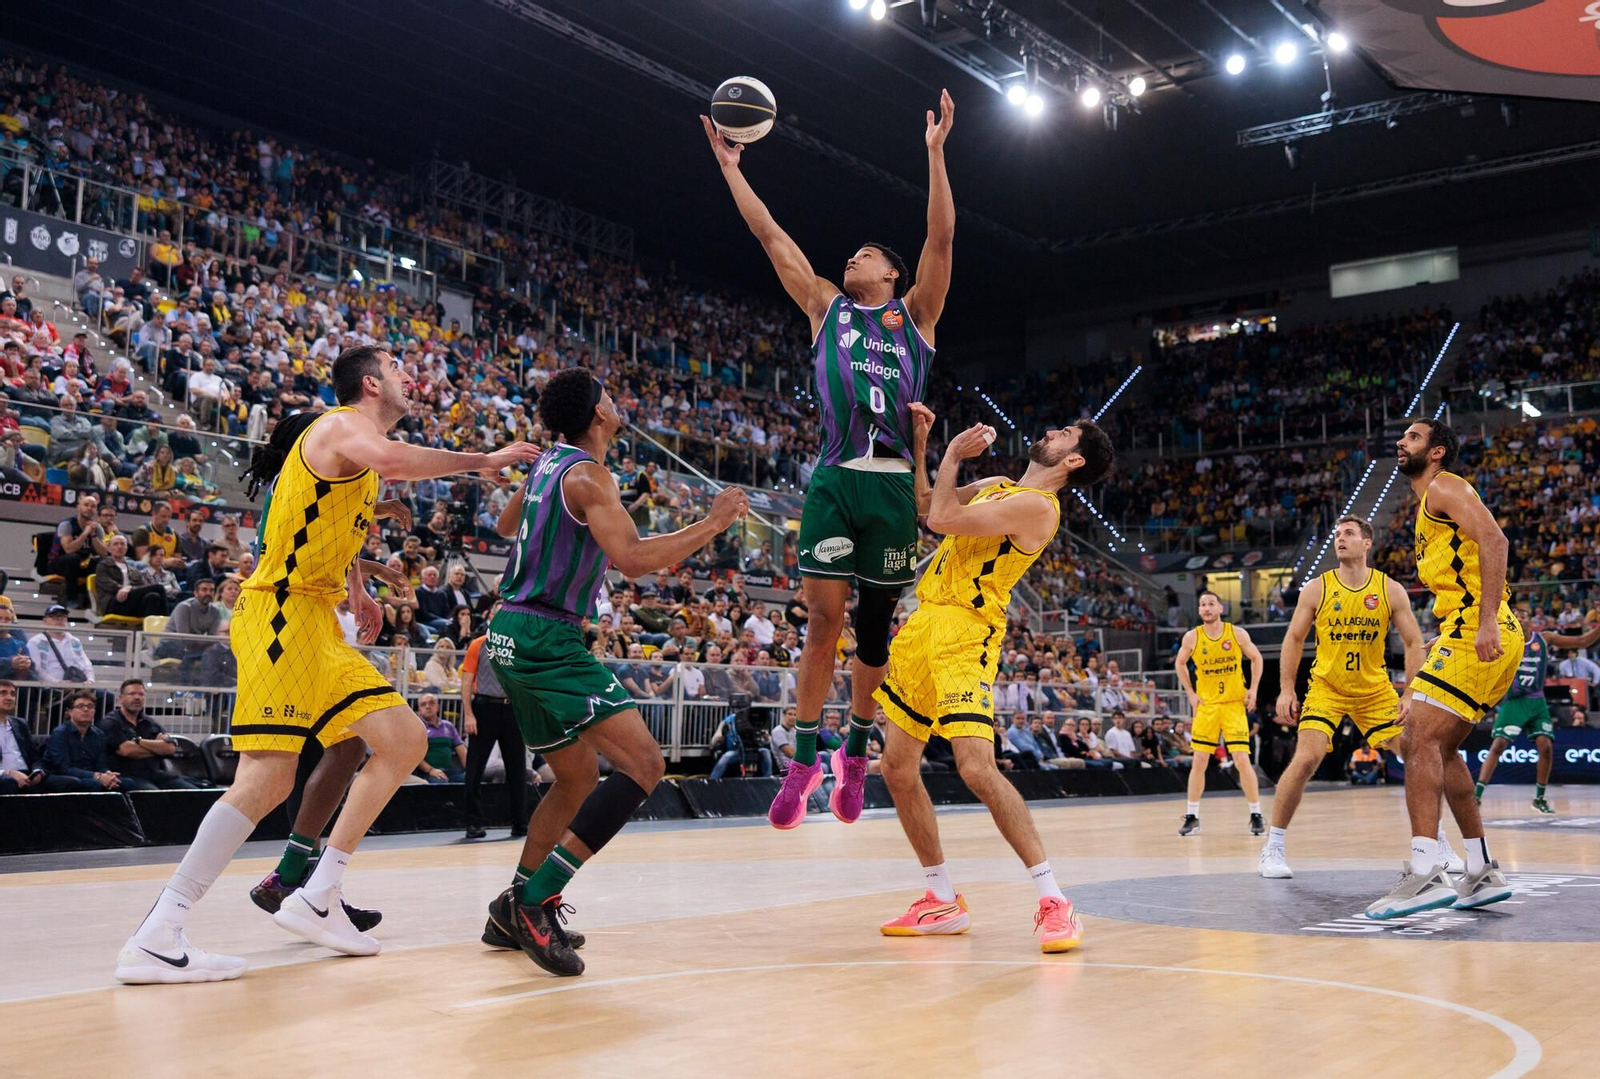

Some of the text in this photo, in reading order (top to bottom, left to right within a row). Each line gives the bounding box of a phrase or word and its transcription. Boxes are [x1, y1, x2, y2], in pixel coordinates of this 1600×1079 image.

[862, 337, 907, 358] Unicaja
[850, 358, 901, 380] málaga
[870, 386, 886, 414] 0
[884, 557, 907, 571] laga
[1328, 616, 1381, 627] LA LAGUNA
[1209, 655, 1237, 665] LAGUNA
[1346, 651, 1360, 671] 21
[1519, 675, 1535, 686] 77
[1218, 681, 1225, 694] 9
[937, 699, 960, 708] anarias
